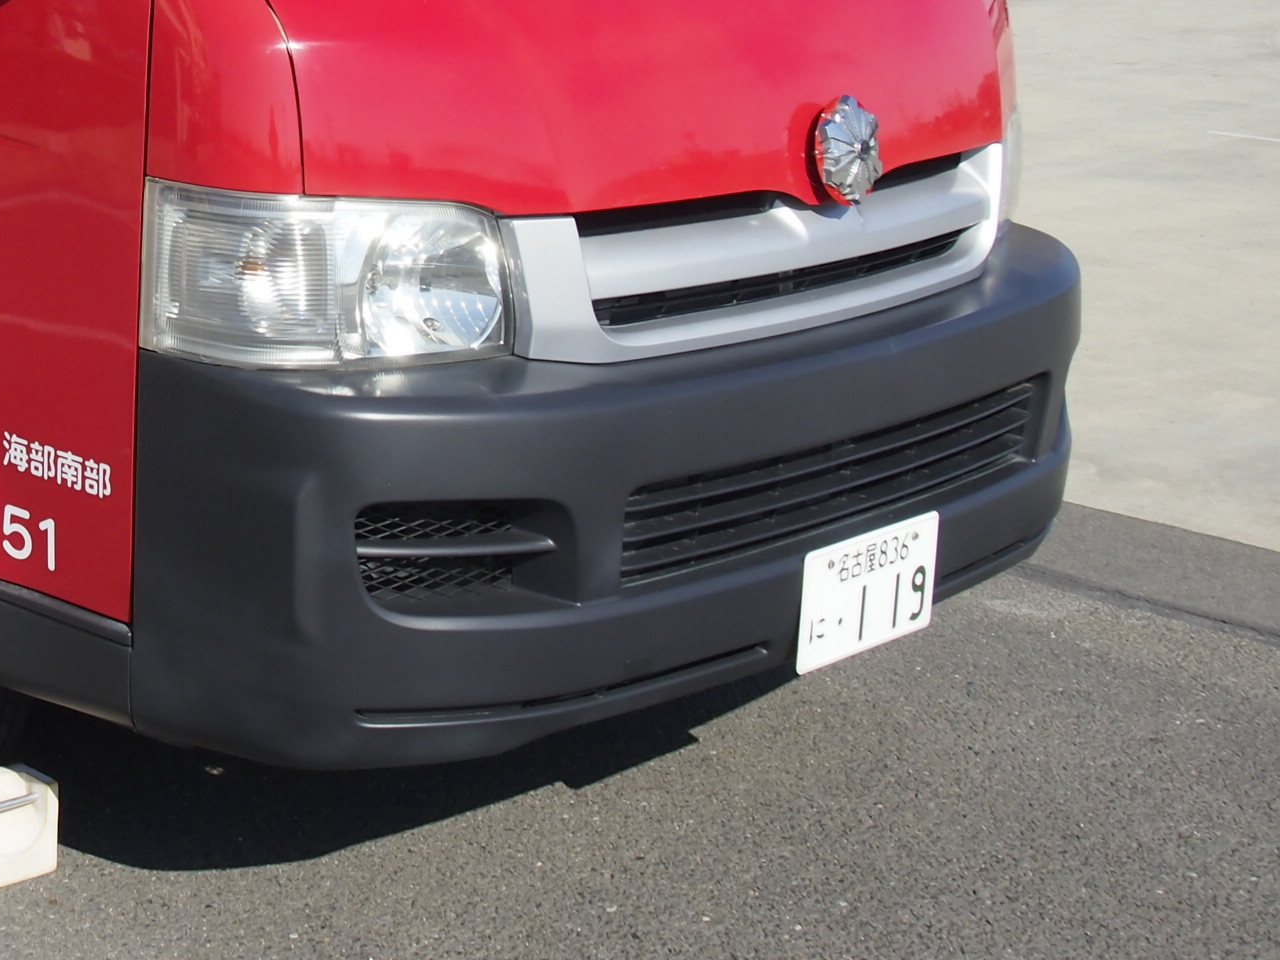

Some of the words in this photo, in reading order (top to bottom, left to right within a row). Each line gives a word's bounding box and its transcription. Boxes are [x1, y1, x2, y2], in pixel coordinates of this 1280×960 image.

[2, 431, 112, 499] 海部南部
[2, 504, 56, 572] 51
